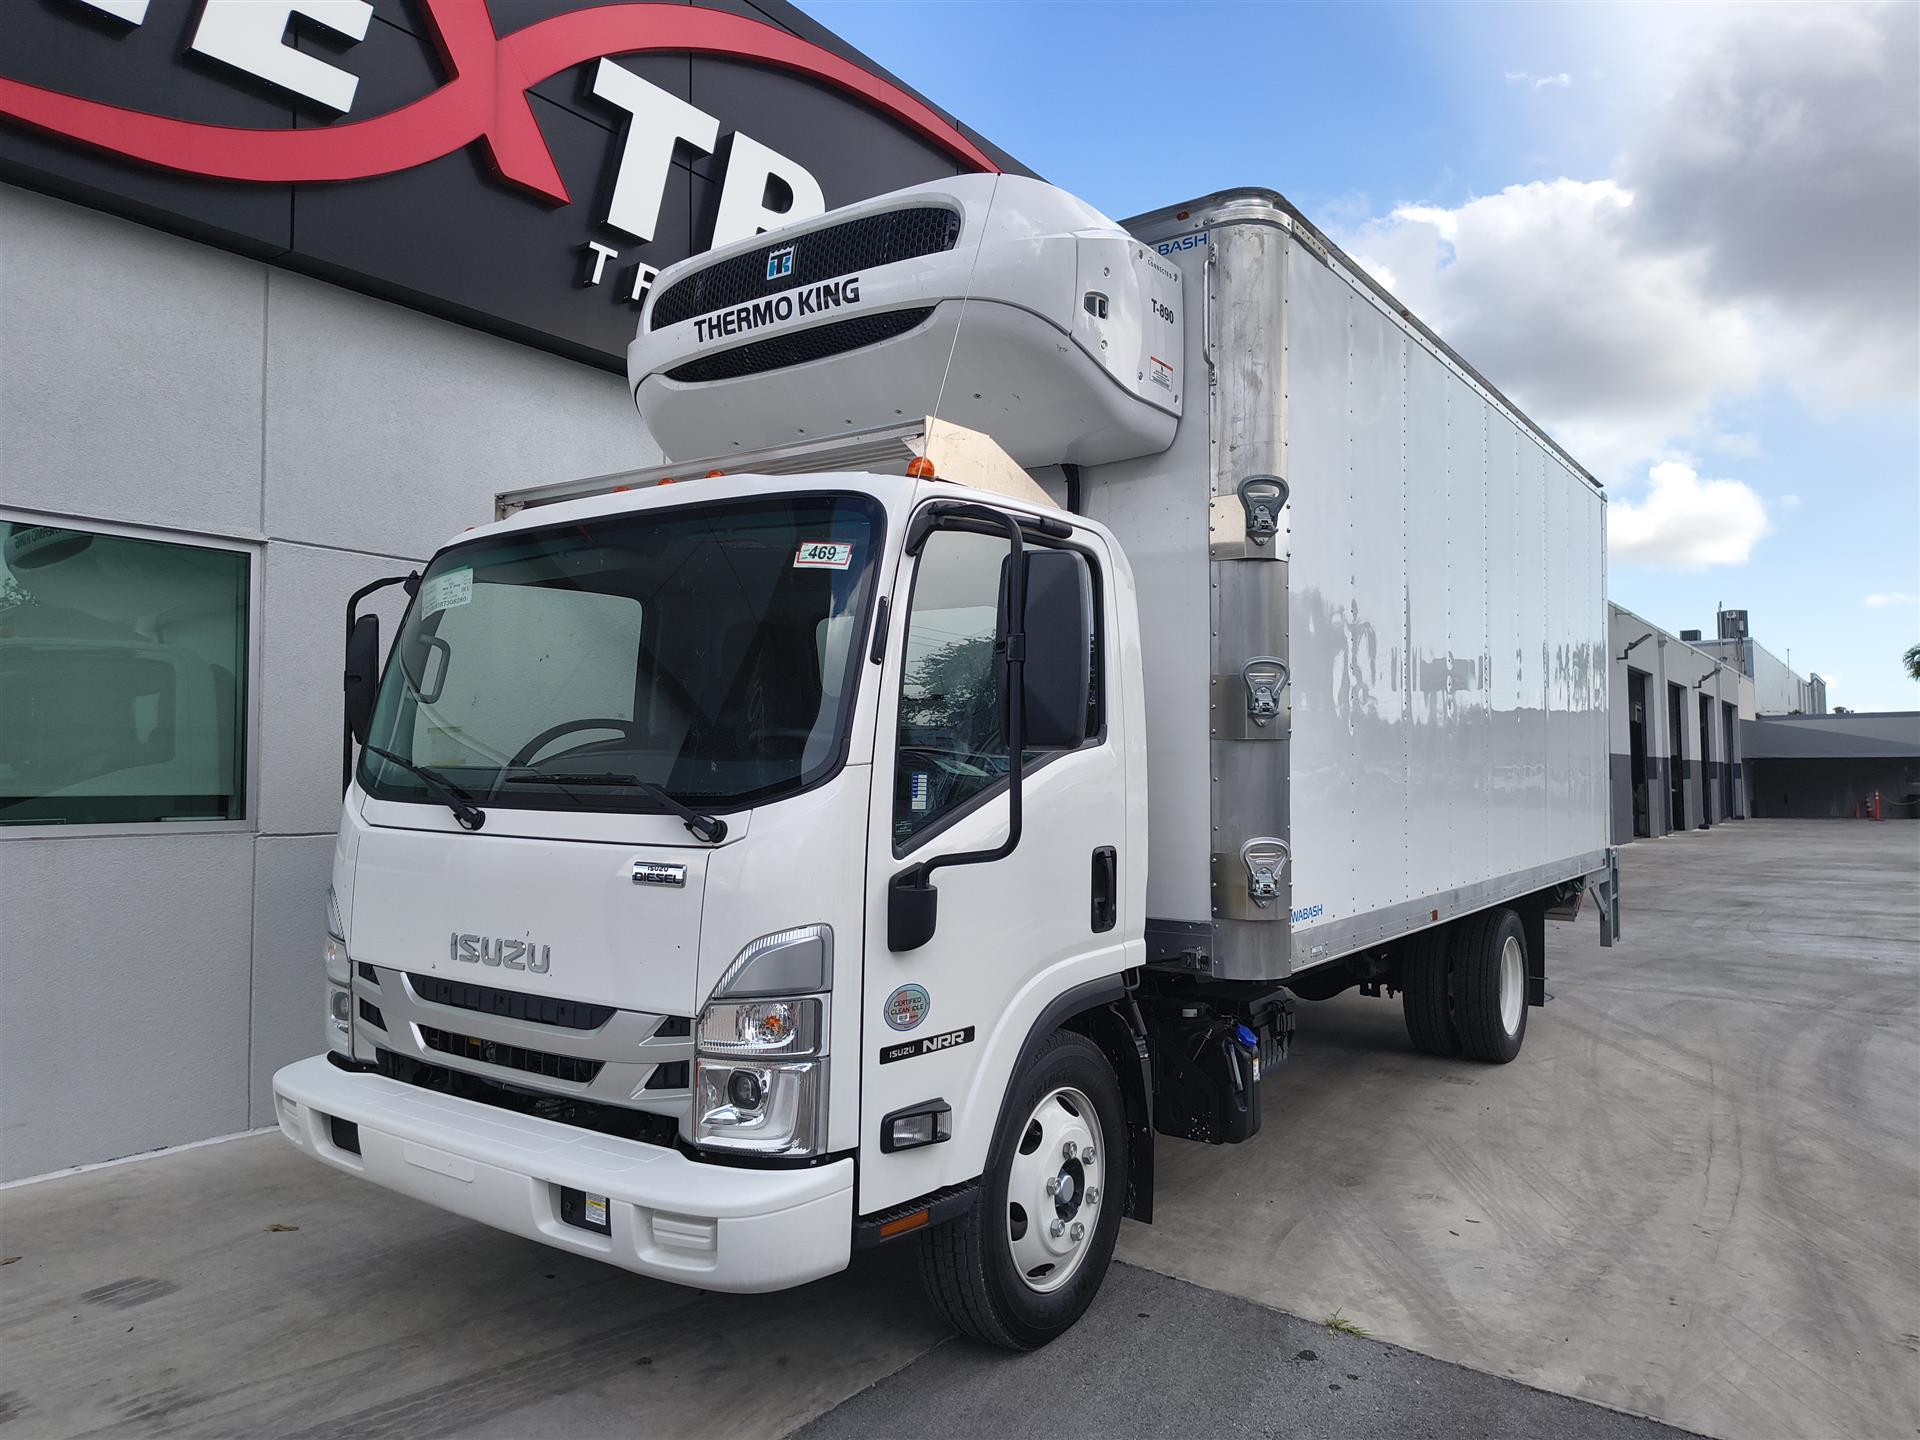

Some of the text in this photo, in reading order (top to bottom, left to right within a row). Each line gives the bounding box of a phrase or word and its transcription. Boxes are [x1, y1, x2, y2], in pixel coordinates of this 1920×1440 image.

[1158, 233, 1207, 256] BASH
[693, 276, 861, 343] THERMO KING
[1151, 298, 1174, 324] T-890
[808, 545, 837, 560] 469
[634, 871, 684, 885] DIESEL
[647, 865, 670, 873] ISUZU
[1291, 904, 1322, 923] WABASH
[450, 931, 551, 975] ISUZU
[891, 1007, 910, 1015] CLEAN
[889, 1030, 965, 1059] ISUZU NRR
